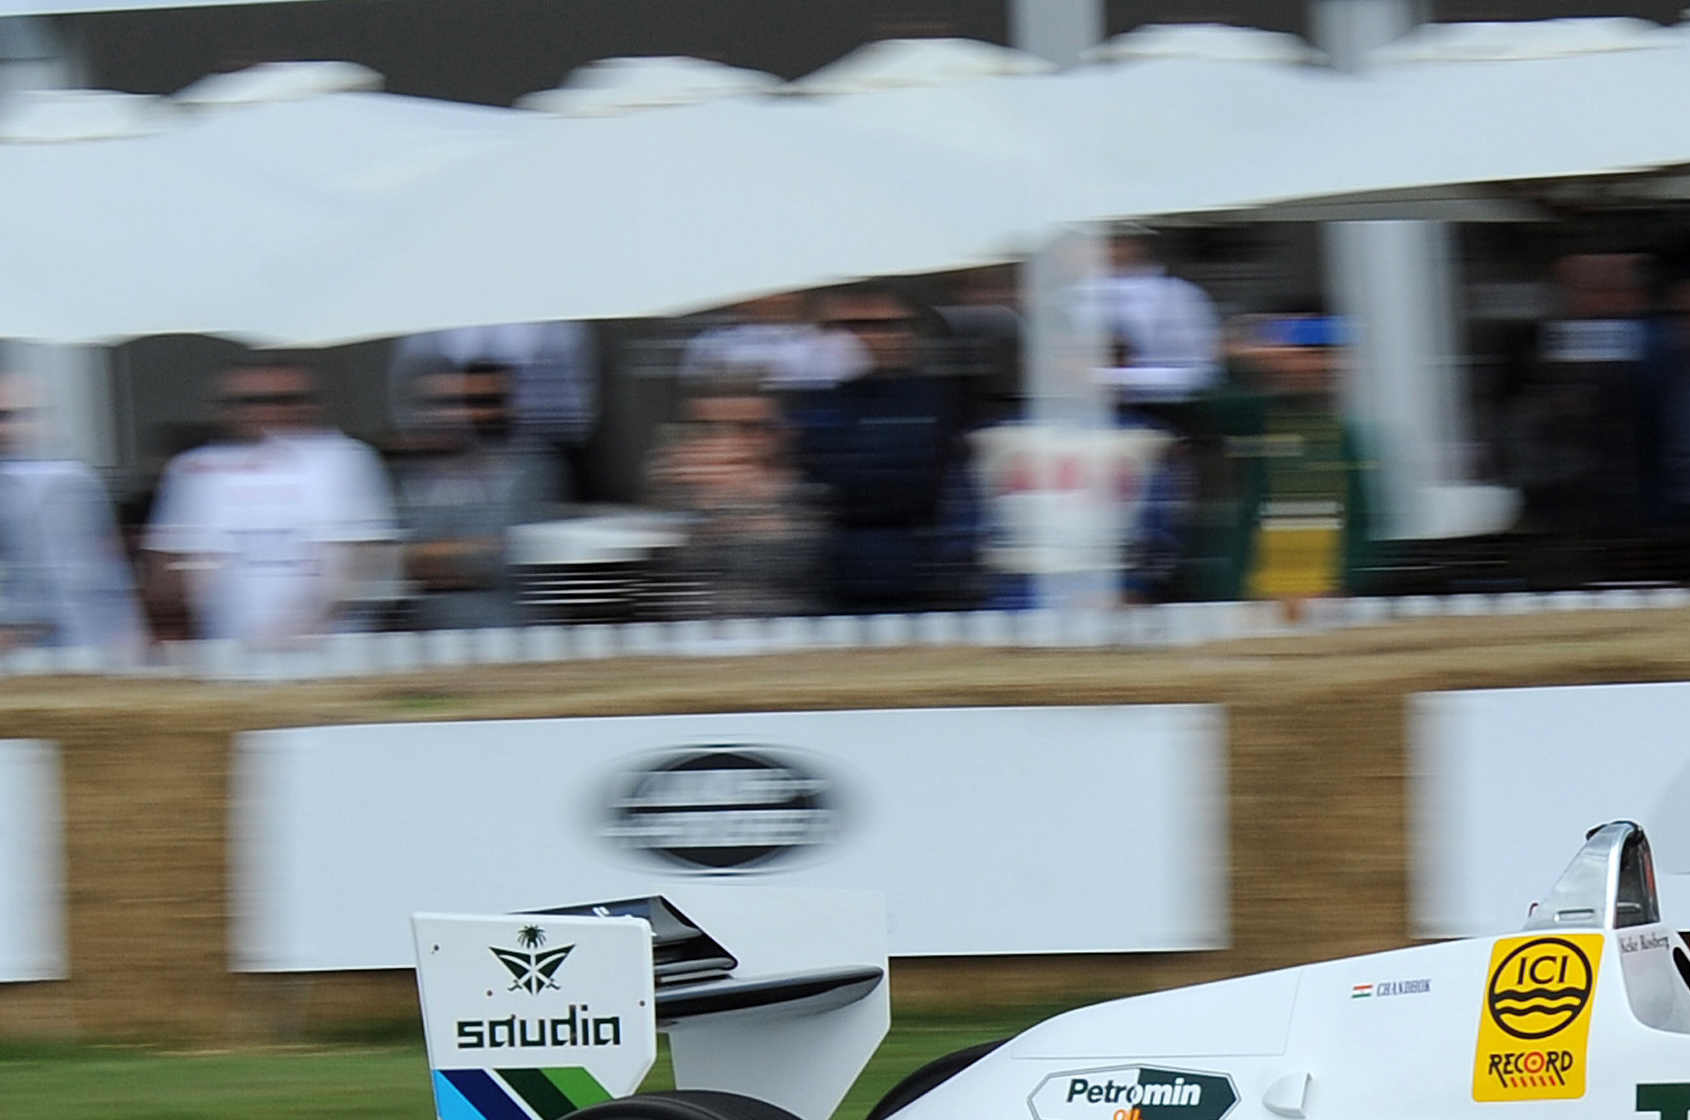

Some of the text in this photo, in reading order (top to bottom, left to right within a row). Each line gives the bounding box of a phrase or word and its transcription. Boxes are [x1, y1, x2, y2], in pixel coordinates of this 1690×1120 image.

[1516, 955, 1569, 985] ICI
[457, 1004, 621, 1049] saudia
[1488, 1050, 1573, 1088] RECORD
[1067, 1078, 1201, 1106] Petromin
